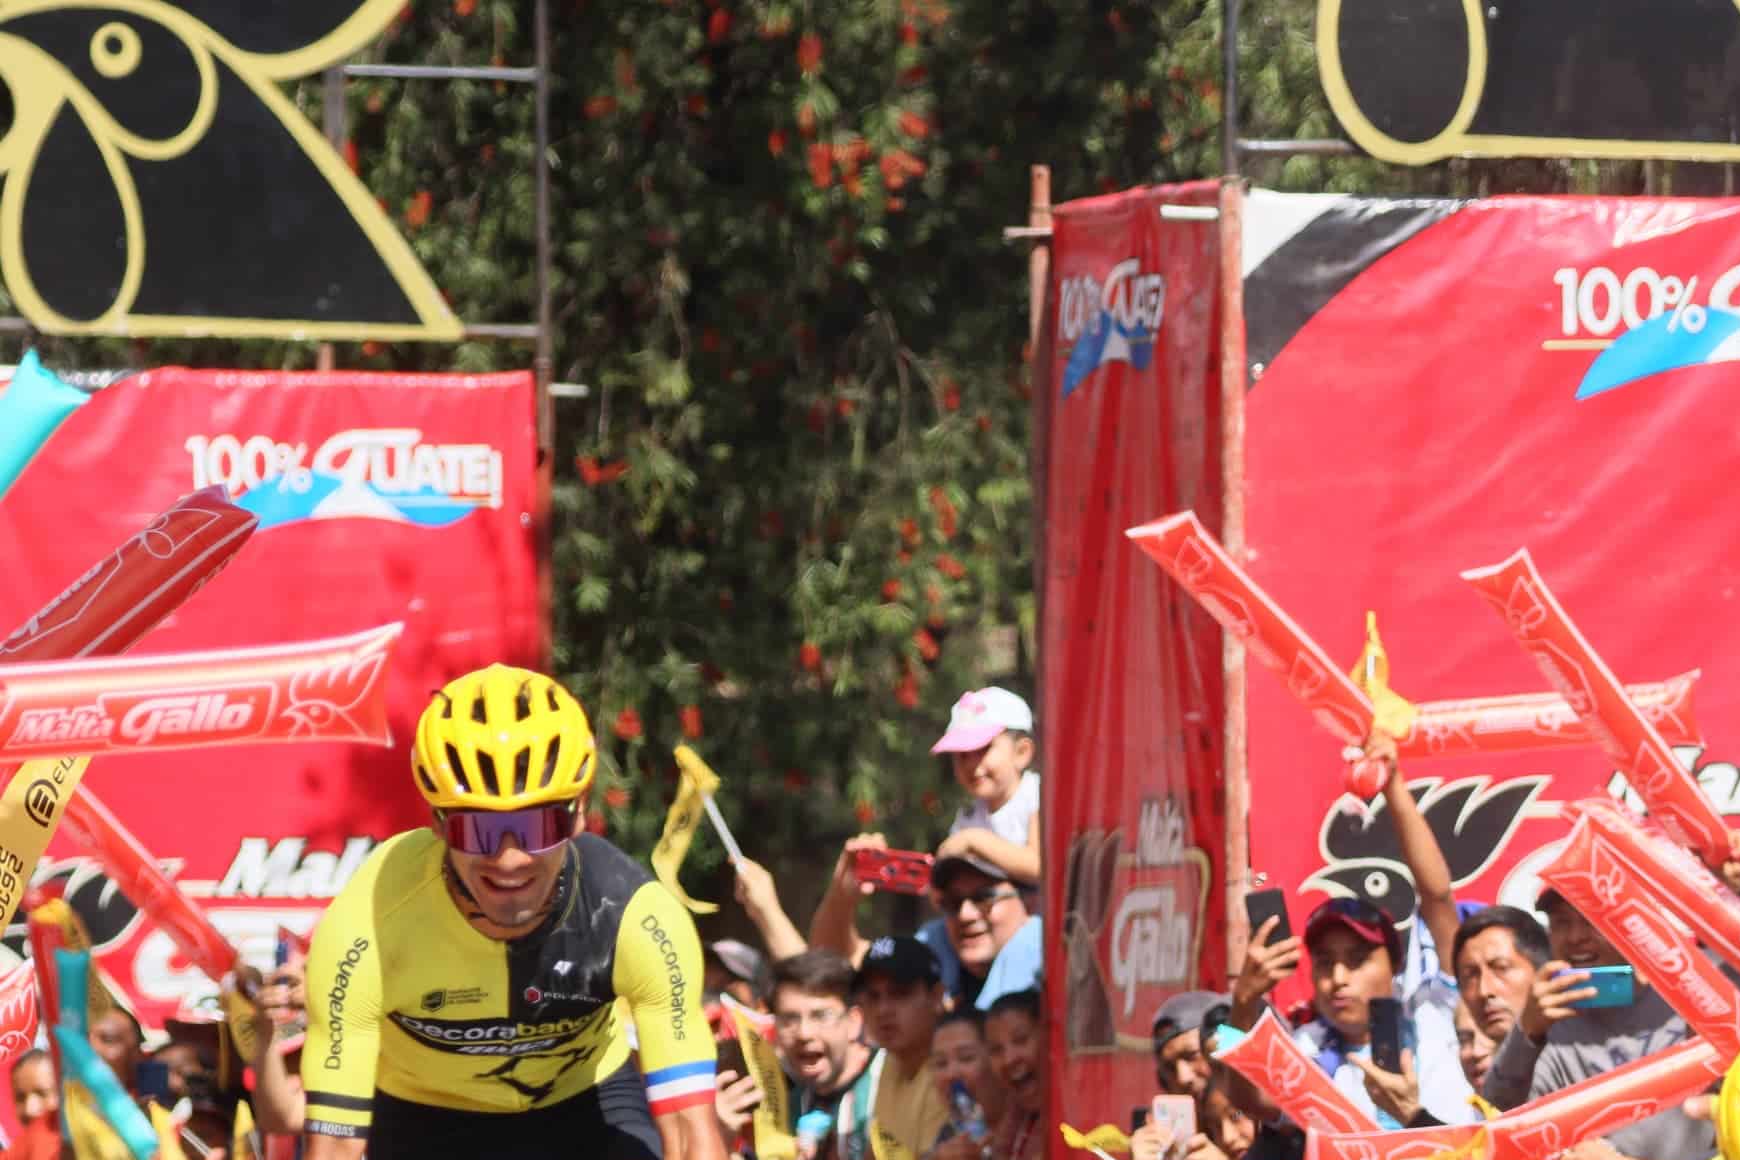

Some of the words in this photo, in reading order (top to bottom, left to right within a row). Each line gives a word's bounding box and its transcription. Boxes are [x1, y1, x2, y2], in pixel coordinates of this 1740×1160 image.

[1553, 266, 1708, 336] 100%
[184, 434, 314, 495] 100%
[14, 706, 114, 743] Malta
[120, 693, 259, 745] Gallo
[218, 836, 375, 898] Mal
[314, 936, 370, 1070] Decorabaños
